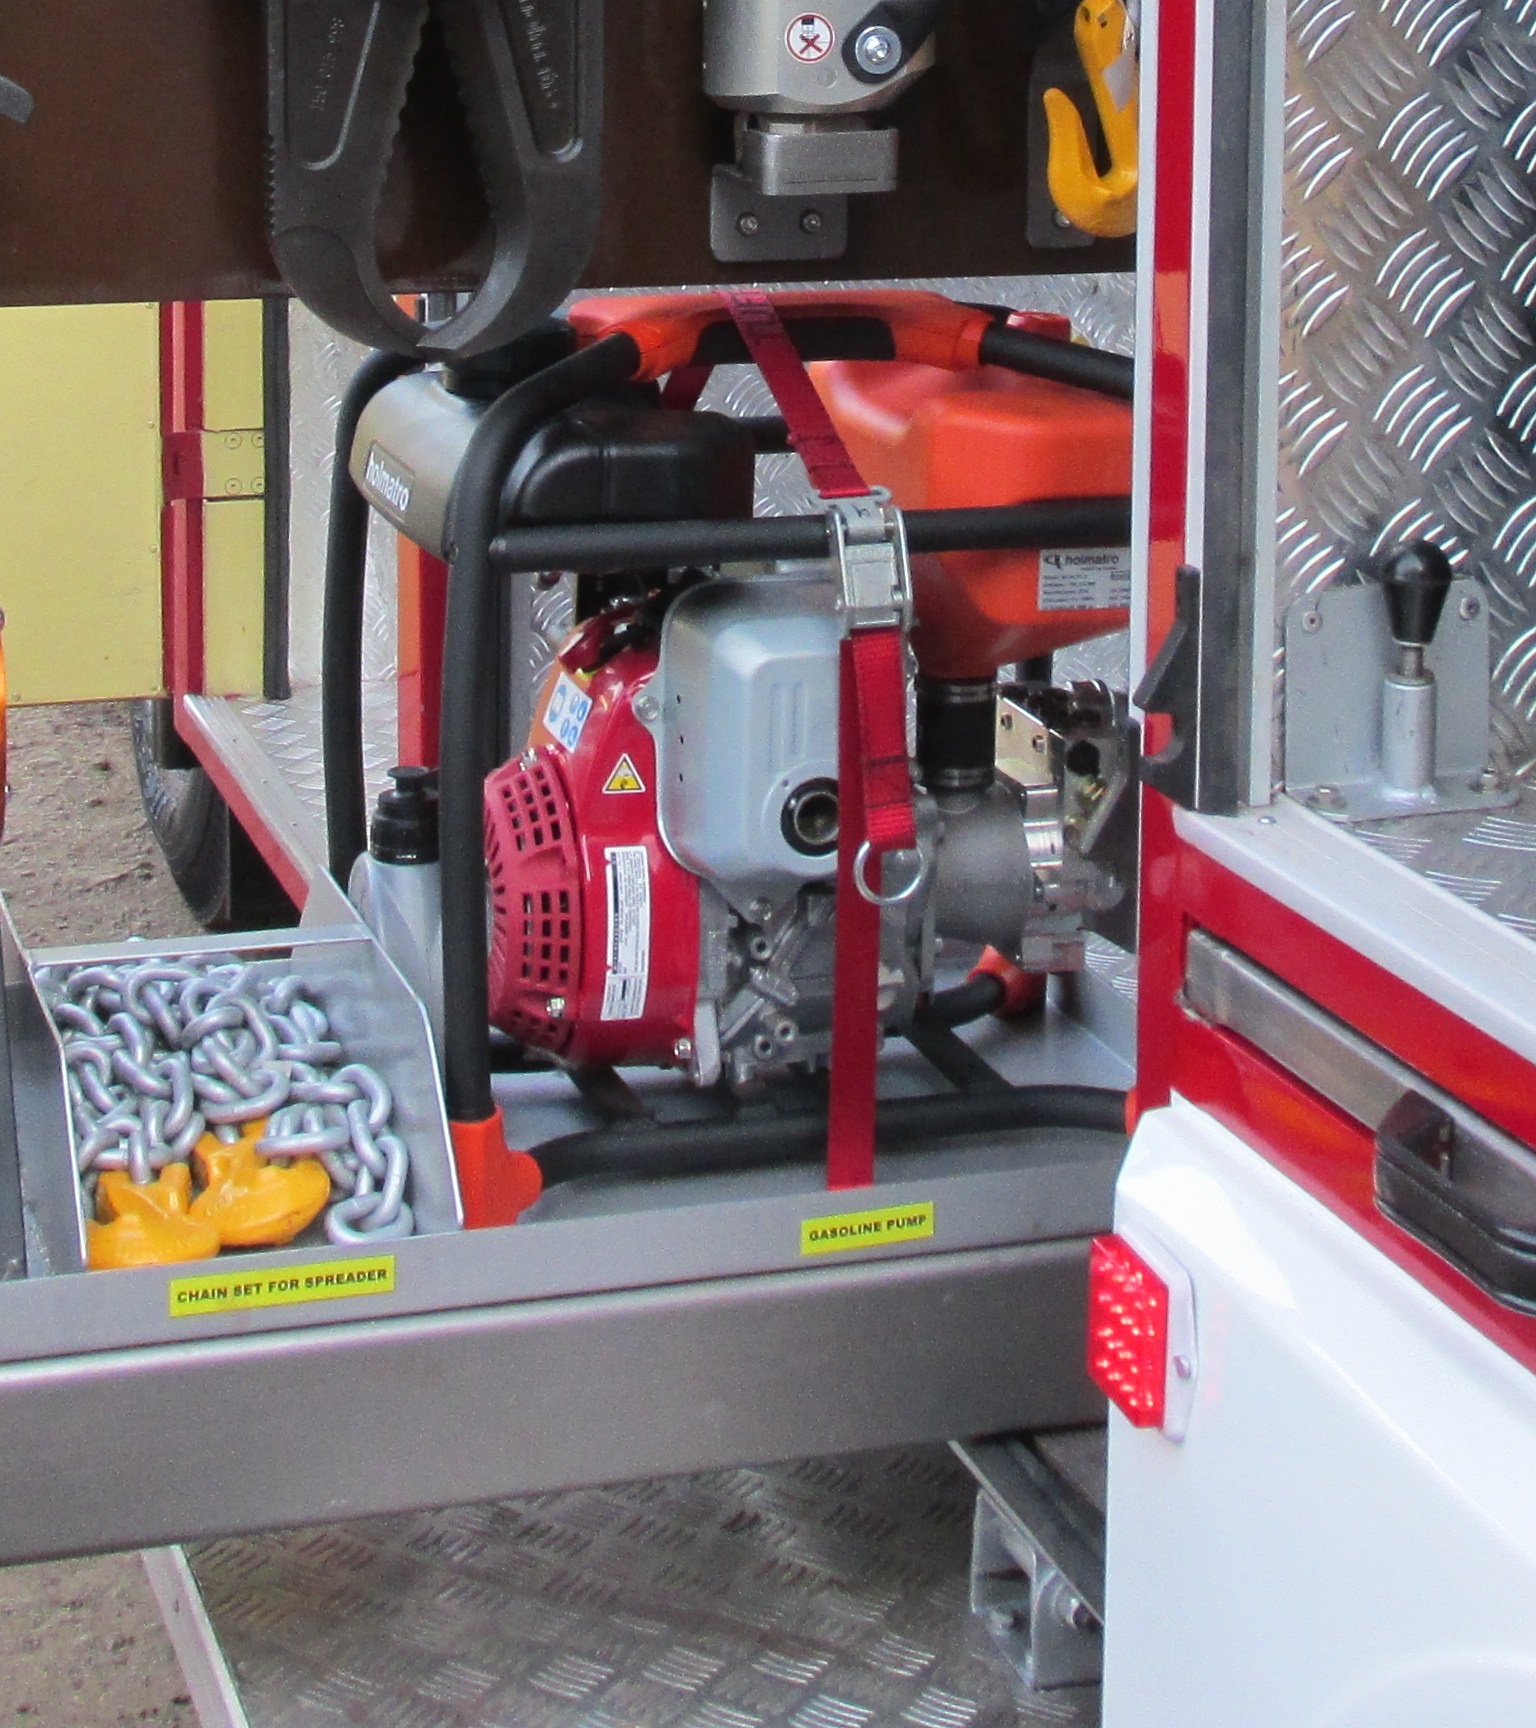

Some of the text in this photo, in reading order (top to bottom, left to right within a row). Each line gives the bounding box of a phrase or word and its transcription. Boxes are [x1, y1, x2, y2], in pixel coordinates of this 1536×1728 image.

[366, 451, 410, 512] holmatro
[1065, 554, 1120, 566] holmatro
[809, 1214, 927, 1241] GASOLINE PUMP
[177, 1268, 388, 1303] CHAIN SET FOR SPREADER
